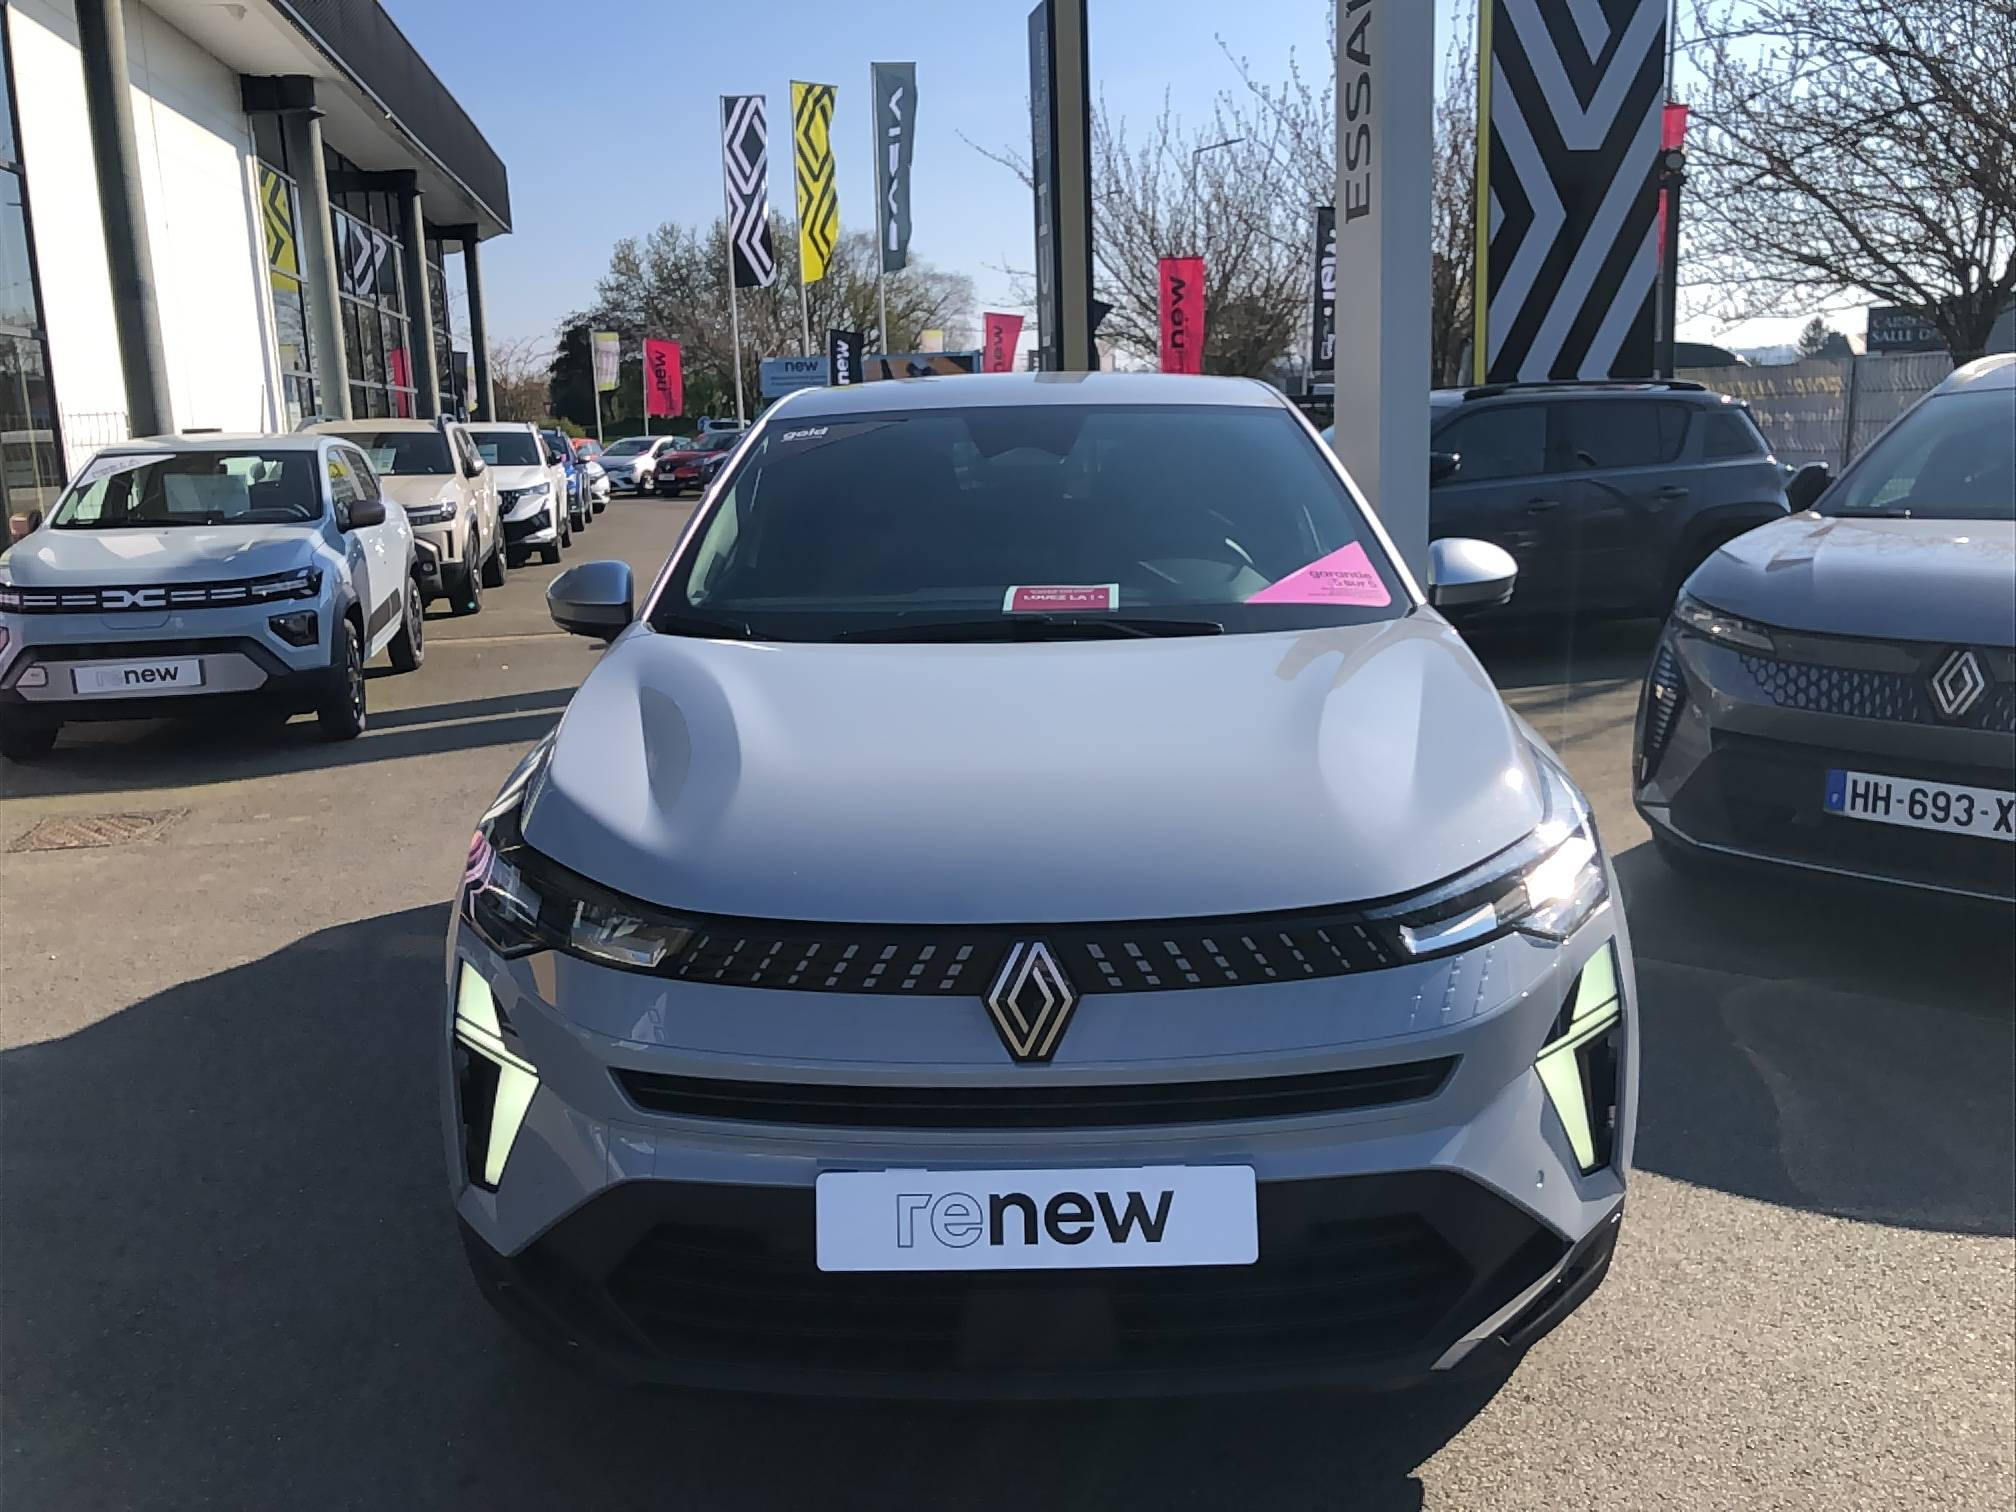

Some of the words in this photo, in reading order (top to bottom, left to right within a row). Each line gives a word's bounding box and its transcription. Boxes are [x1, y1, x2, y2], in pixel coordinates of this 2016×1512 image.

[784, 361, 818, 372] new
[836, 340, 850, 385] new
[783, 426, 829, 441] gold
[1309, 570, 1373, 580] garantie
[896, 1189, 1175, 1249] renew
